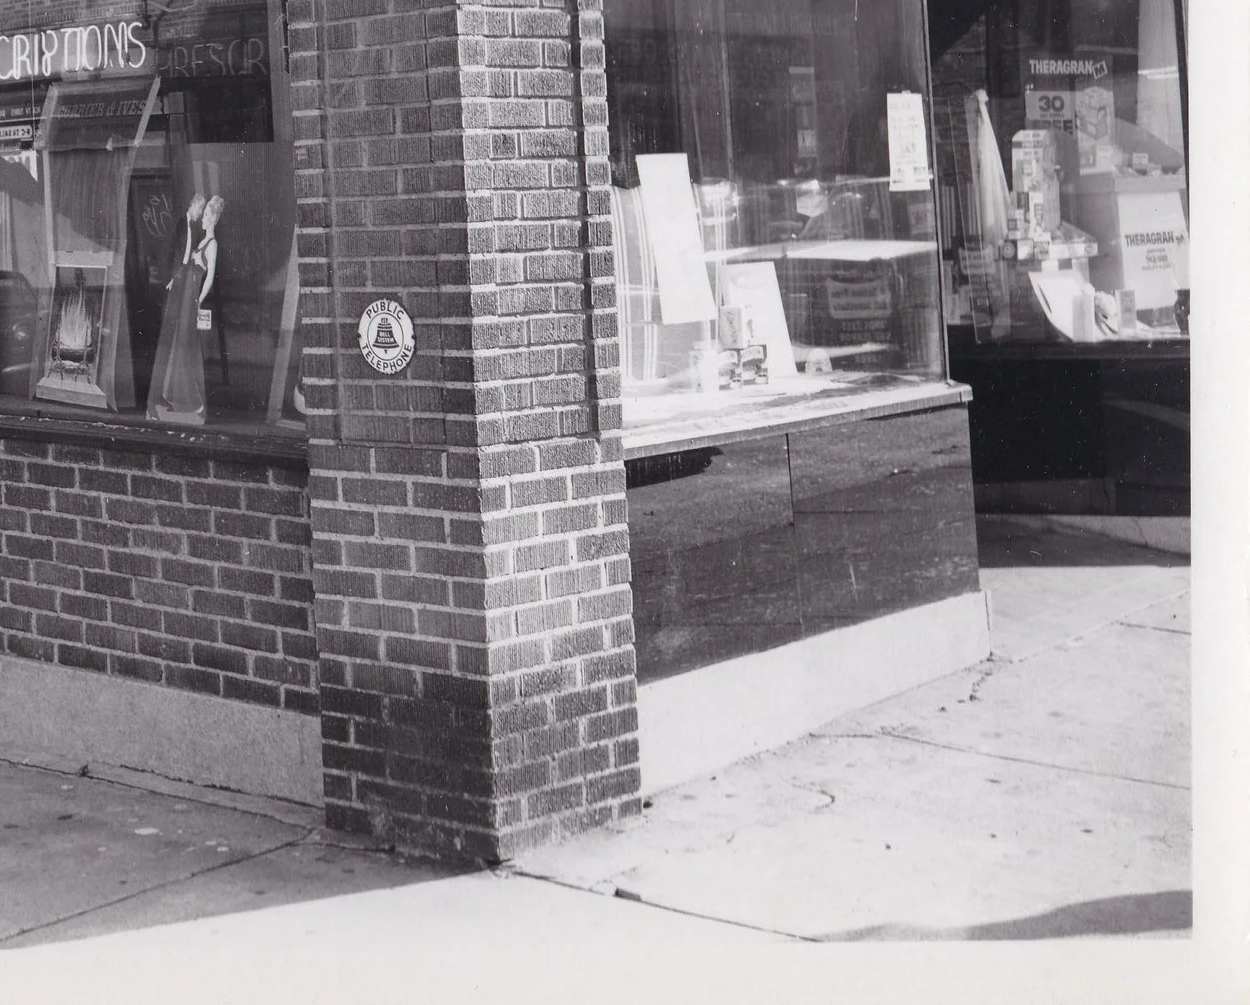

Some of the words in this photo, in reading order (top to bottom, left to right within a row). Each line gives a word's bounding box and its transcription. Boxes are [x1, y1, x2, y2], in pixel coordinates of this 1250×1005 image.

[1029, 59, 1095, 75] THERAGRAN
[1038, 95, 1065, 113] 30
[1124, 231, 1175, 247] THERAGRAN
[365, 301, 405, 320] PUBLIC
[362, 343, 412, 371] TELEPHONE
